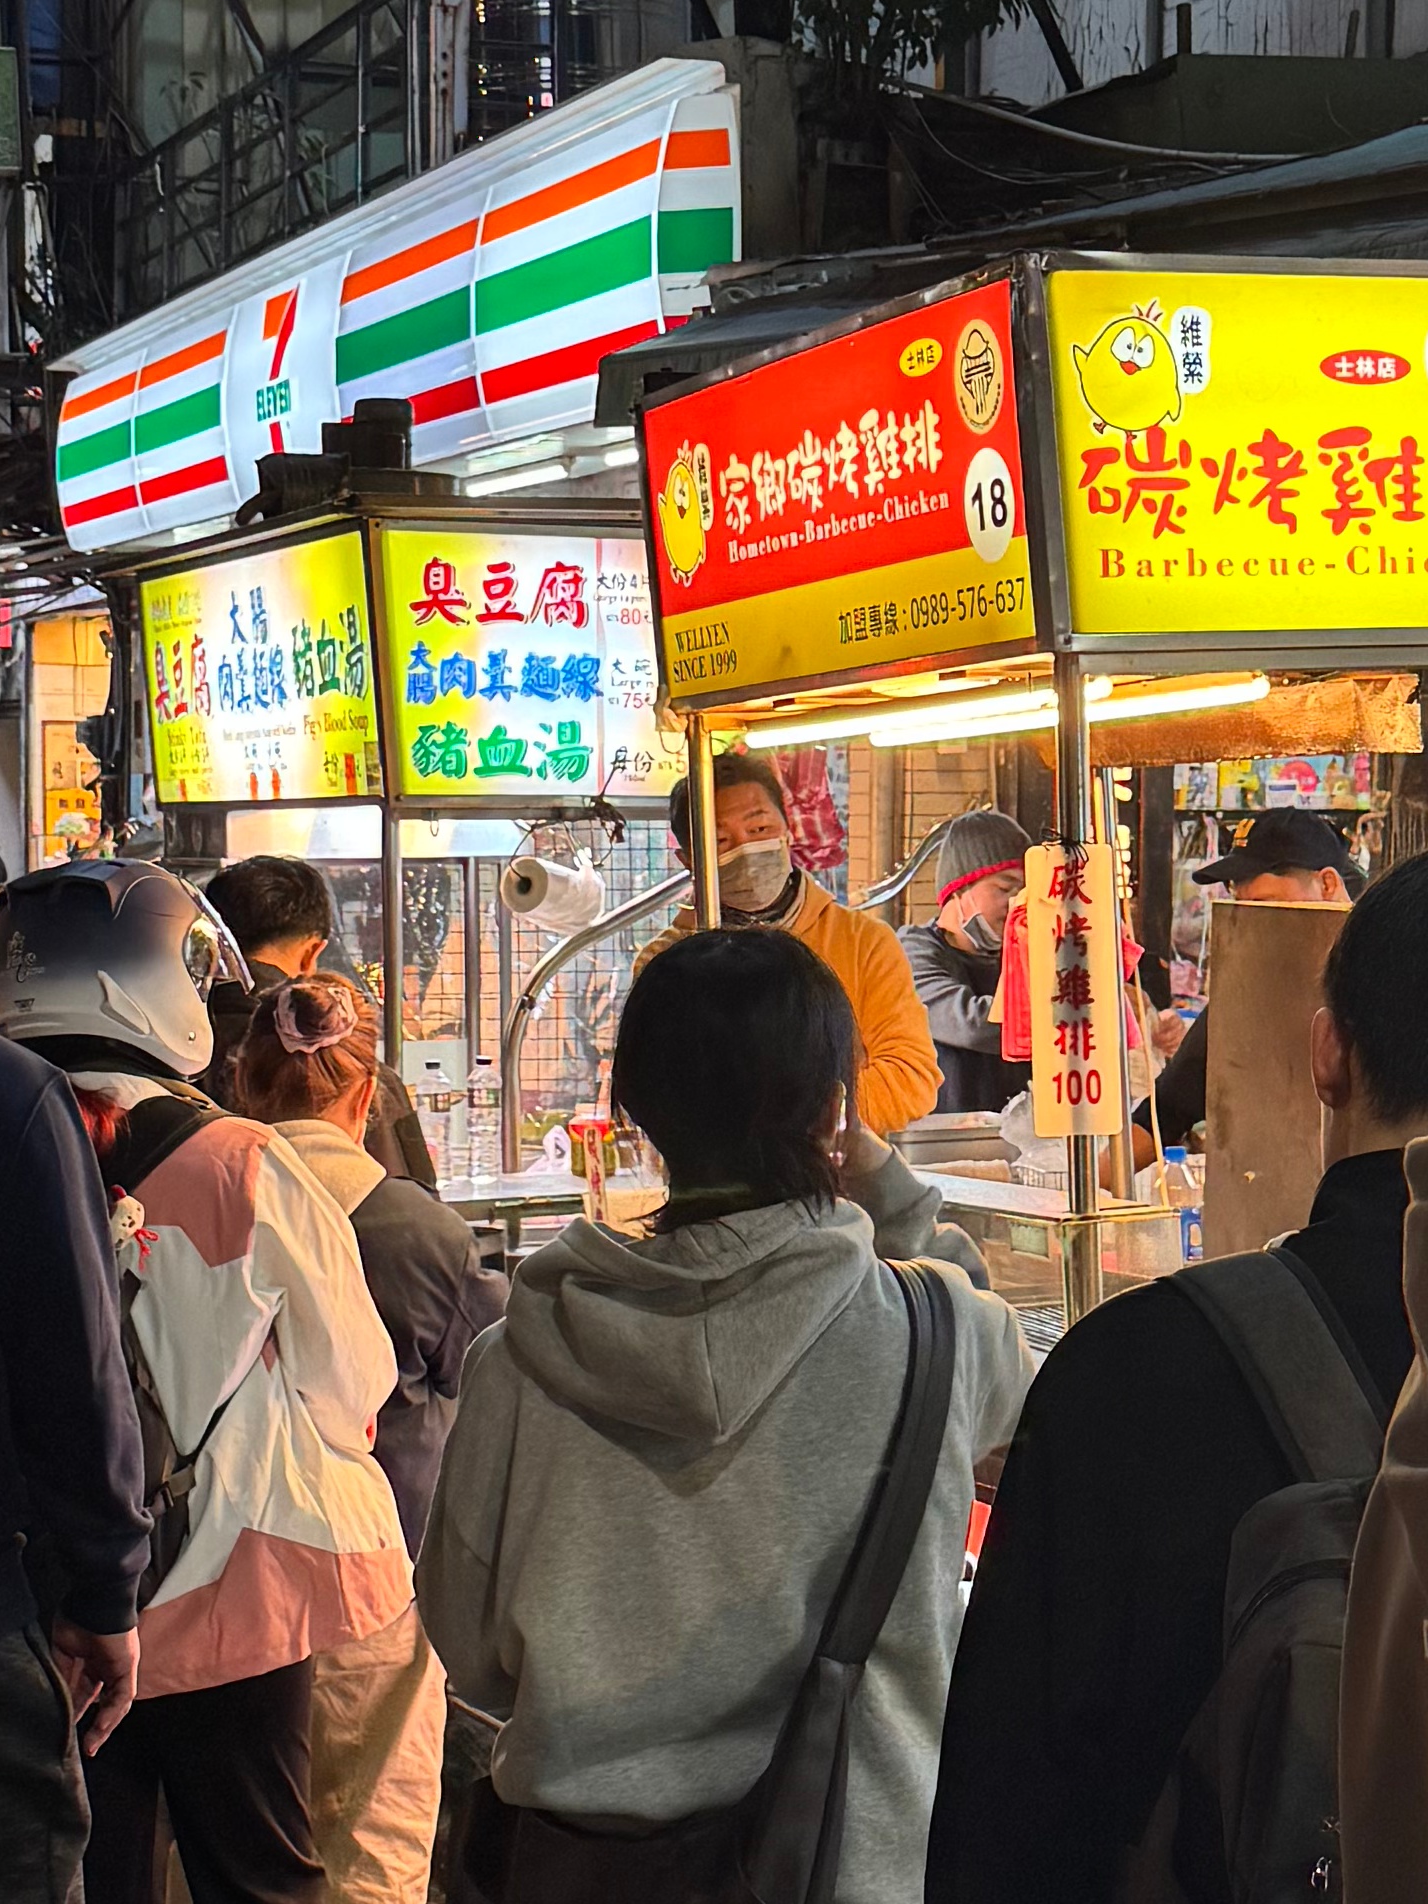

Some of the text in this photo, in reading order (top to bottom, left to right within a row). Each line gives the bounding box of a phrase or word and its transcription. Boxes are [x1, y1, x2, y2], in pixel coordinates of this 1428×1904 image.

[1335, 356, 1397, 379] 士林店
[720, 399, 944, 535] 家鄉碳烤雞排
[727, 490, 950, 564] Hometown-Barbecue-Chicken
[971, 478, 1008, 532] 18
[409, 556, 590, 629] 臭豆腐
[910, 577, 1026, 630] 0989-576-637
[154, 634, 212, 724] 臭豆腐
[291, 604, 368, 701] 豬血湯
[674, 621, 730, 653] WELLYEN
[672, 649, 738, 684] SINCE 1999
[411, 720, 594, 781] 豬血湯
[1047, 864, 1097, 1064] 碳烤雞排
[1051, 1069, 1102, 1105] 100
